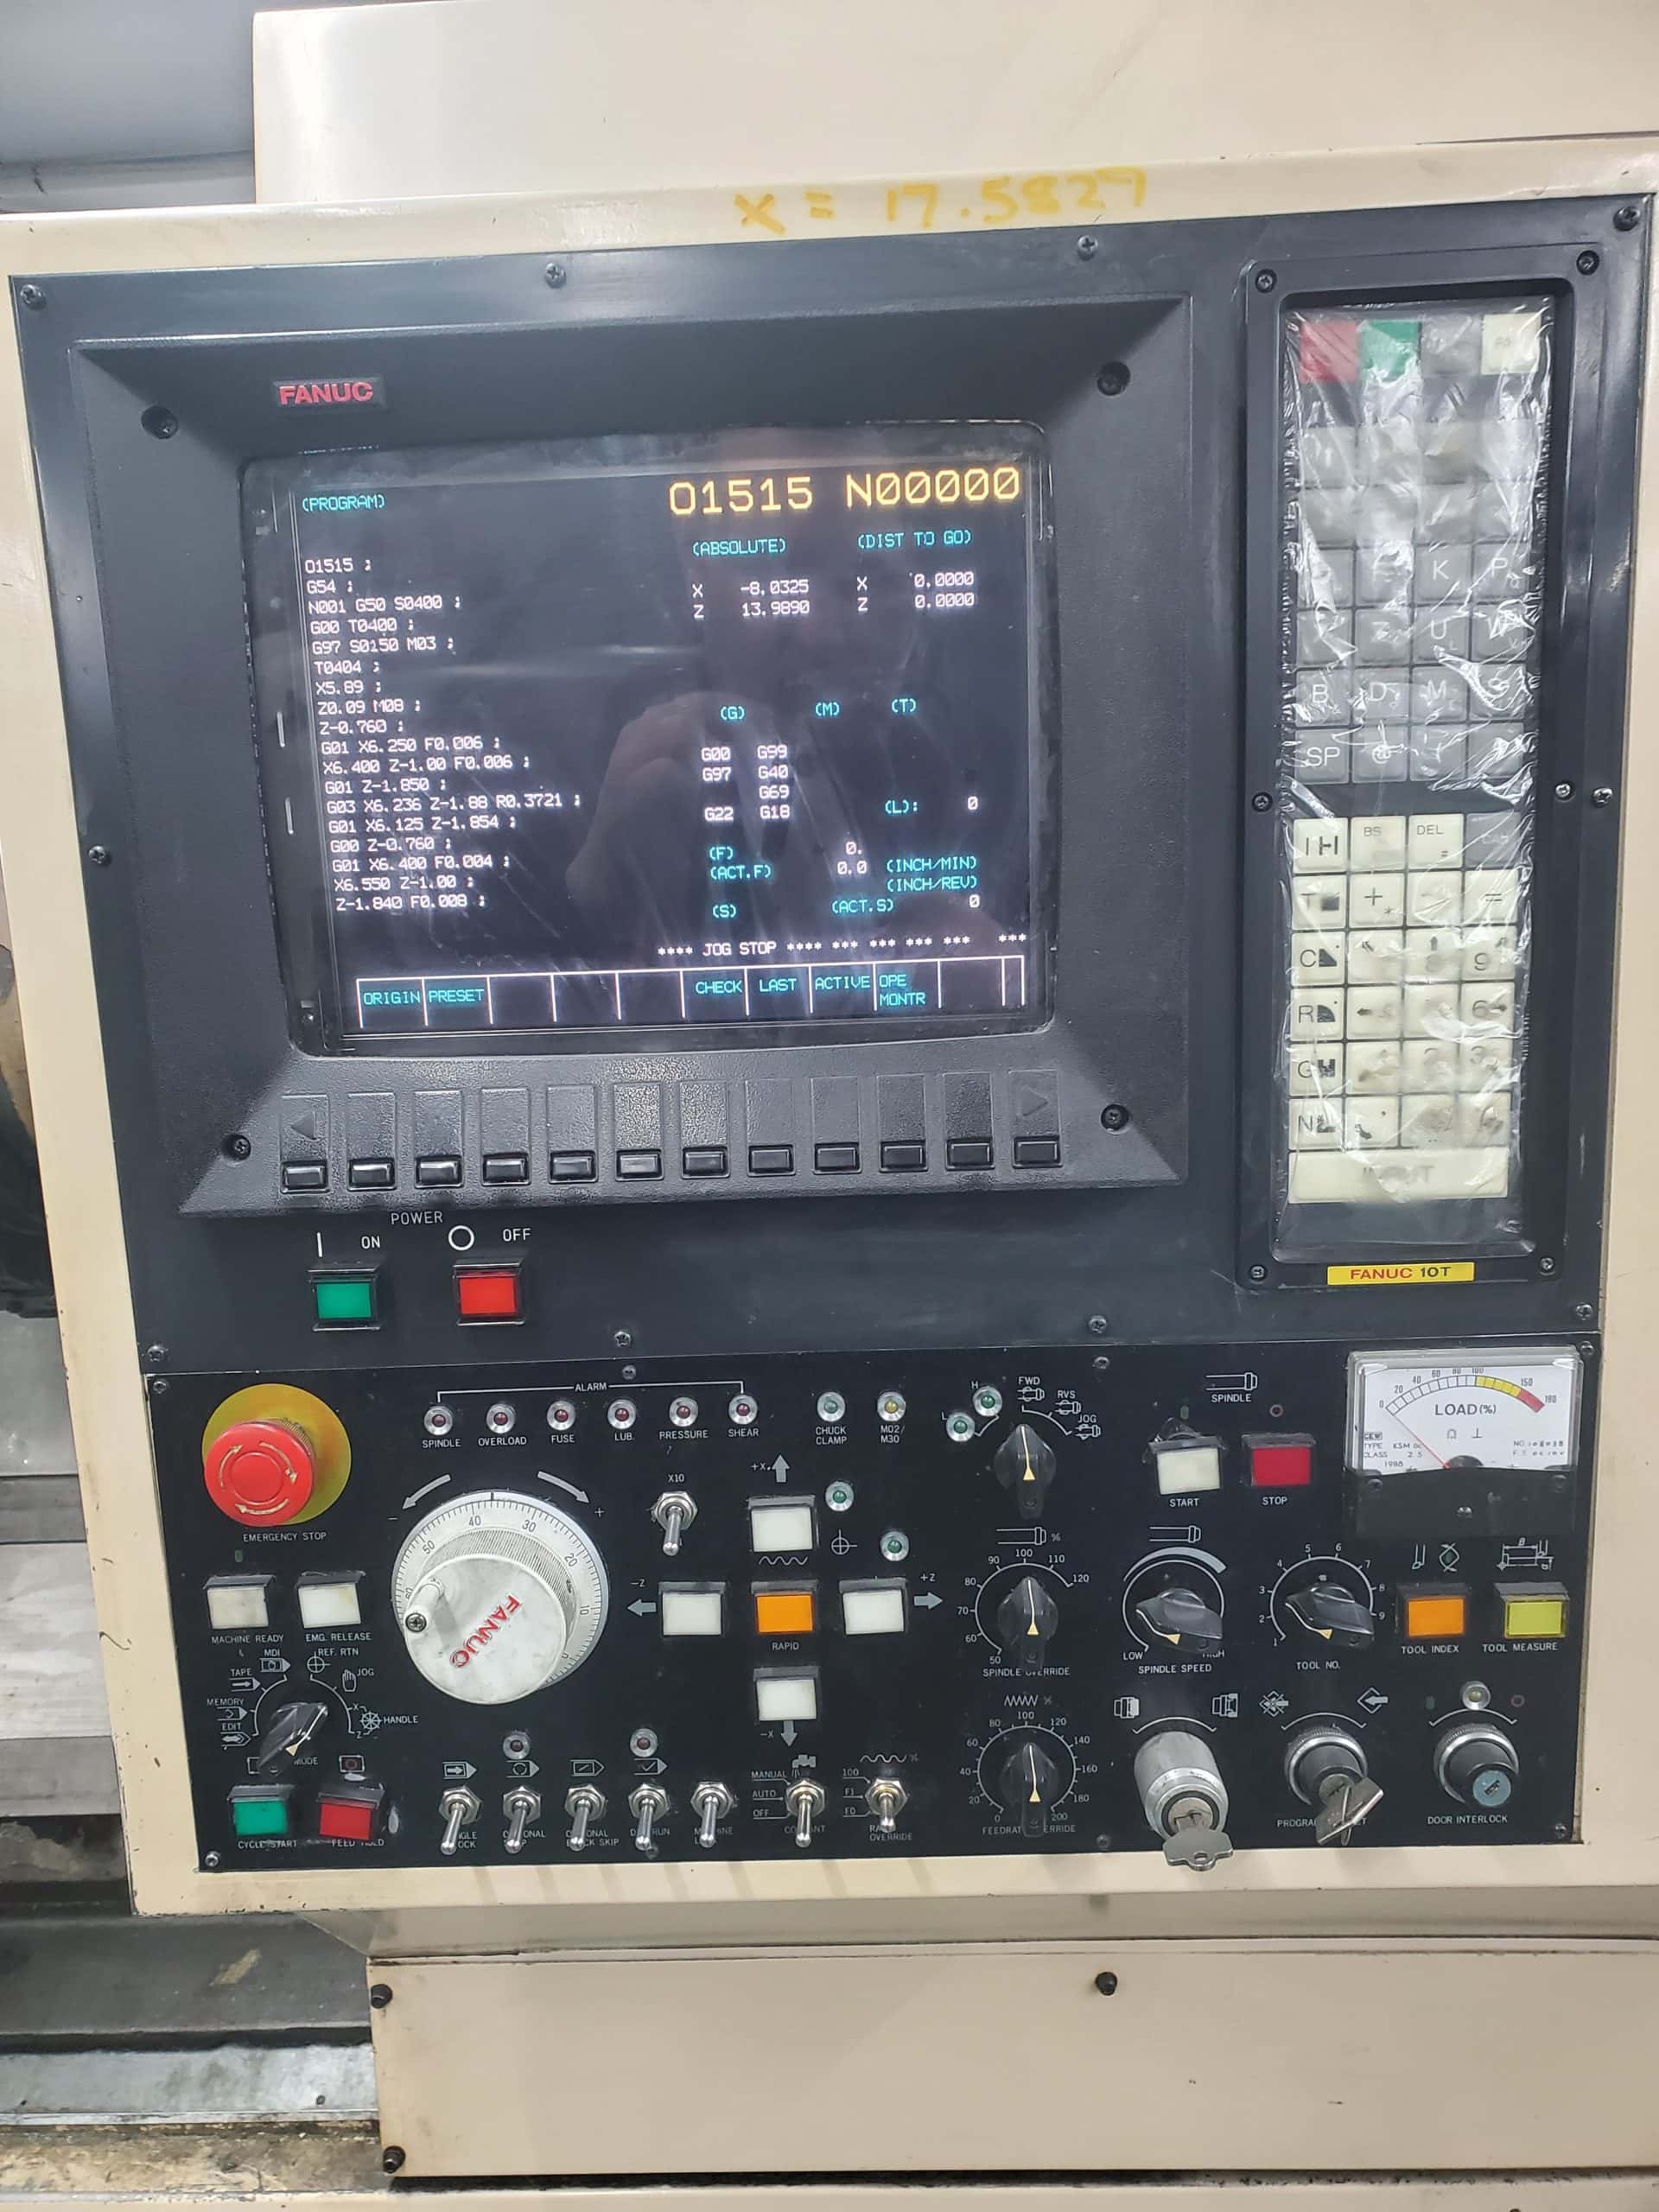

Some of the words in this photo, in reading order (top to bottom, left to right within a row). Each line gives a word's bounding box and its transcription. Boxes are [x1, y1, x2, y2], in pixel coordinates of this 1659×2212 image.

[887, 166, 1147, 229] 17.5827
[278, 382, 374, 405] FANUC
[669, 476, 814, 516] O1515
[845, 467, 1020, 508] N00000
[302, 493, 385, 512] (PROGRAM)
[692, 536, 787, 557] (ABSOLUTE)
[858, 531, 905, 550] (DIST
[943, 529, 973, 547] GO)
[307, 580, 336, 594] G54
[856, 576, 868, 591] X
[914, 571, 975, 588] 0.0000
[692, 583, 703, 598] X
[740, 579, 810, 596] -8.0325
[308, 600, 346, 615] N001
[355, 597, 386, 613] G50
[394, 594, 443, 611] S0400
[914, 593, 975, 608] 0.0000
[741, 601, 810, 618] 13.9890
[310, 620, 340, 634] G00
[348, 617, 397, 633] T0400
[312, 640, 340, 655] G97
[349, 638, 399, 653] S0150
[407, 636, 436, 652] M03
[314, 659, 362, 675] T0404
[315, 679, 364, 696] X5.89
[317, 700, 365, 715] Z0.09
[373, 698, 404, 713] M08
[720, 705, 746, 721] (G)
[815, 702, 840, 717] (M)
[891, 698, 917, 714] (T)
[320, 719, 387, 735] Z-0.760
[321, 741, 349, 755] G01
[359, 738, 417, 753] X6.250
[424, 735, 483, 752] F0.006
[701, 747, 731, 762] G00
[757, 744, 788, 760] G99
[323, 760, 380, 775] X6.400
[389, 757, 447, 772] Z-1.00
[454, 754, 513, 770] F0.006
[702, 766, 732, 782] G97
[758, 765, 788, 779] G40
[325, 780, 353, 795] G01
[362, 778, 429, 793] Z-1.850
[759, 785, 789, 799] G69
[327, 800, 356, 814] G03
[364, 798, 423, 813] X6.236
[429, 795, 488, 810] Z-1.88
[496, 792, 563, 809] R0.3721
[704, 807, 734, 822] G22
[760, 804, 790, 820] G18
[328, 820, 356, 835] G01
[365, 817, 423, 833] X6.125
[432, 815, 499, 830] Z-1.854
[1416, 824, 1444, 836] DEL
[331, 840, 359, 854] G00
[367, 836, 435, 852] Z-0.760
[709, 846, 734, 861] (F)
[332, 859, 359, 873] G01
[369, 856, 427, 872] X6.400
[435, 855, 493, 869] F0.004
[710, 864, 772, 880] (ACT.F)
[837, 861, 868, 875] 0.0
[887, 856, 977, 873] (INCH/MIN)
[334, 876, 391, 892] X6.550
[400, 874, 456, 890] Z-1.00
[887, 875, 978, 892] (INCH/REV)
[336, 895, 403, 912] Z-1.840
[410, 893, 467, 909] F0.008
[712, 904, 737, 919] (S)
[832, 899, 894, 914] (ACT.S)
[702, 942, 733, 957] JOG
[740, 940, 777, 956] STOP
[695, 980, 743, 995] CHECK
[759, 977, 798, 993] LAST
[815, 975, 871, 991] ACTIVE
[879, 973, 907, 988] OPE
[363, 991, 421, 1006] ORIGIN
[428, 988, 485, 1003] PRESET
[879, 992, 926, 1007] MONTR
[391, 1211, 443, 1224] POWER
[502, 1228, 531, 1242] OFF
[361, 1236, 381, 1249] ON
[1350, 1268, 1413, 1281] FANUC
[1420, 1266, 1452, 1279] 10T
[575, 1382, 607, 1392] ALARM
[1018, 1376, 1040, 1386] FWD
[1057, 1389, 1076, 1400] RVS
[1211, 1393, 1252, 1404] SPINDLE
[1077, 1414, 1097, 1424] JOG
[550, 1433, 575, 1444] FUSE
[659, 1429, 709, 1440] PRESSURE
[728, 1427, 760, 1438] SHEAR
[815, 1427, 846, 1436] CHUCK
[422, 1438, 461, 1448] SPINDLE
[478, 1436, 527, 1446] OVERLOAD
[815, 1436, 848, 1446] CLAMP
[1169, 1497, 1199, 1508] START
[1262, 1496, 1287, 1507] STOP
[468, 1515, 482, 1527] 40
[521, 1519, 537, 1533] 30
[243, 1533, 298, 1542] EMERGENCY
[302, 1531, 327, 1541] STOP
[564, 1552, 578, 1568] 20
[1015, 1549, 1033, 1558] 100
[1048, 1554, 1065, 1564] 110
[1072, 1574, 1090, 1583] 120
[212, 1635, 251, 1643] MACHINE
[255, 1634, 284, 1643] READY
[331, 1632, 372, 1641] RELEASE
[449, 1594, 522, 1669] FANUC
[340, 1647, 359, 1656] RTN
[772, 1642, 800, 1651] RAPID
[1401, 1645, 1427, 1655] TOOL
[1431, 1644, 1460, 1654] INDEX
[1482, 1643, 1507, 1653] TOOL
[1512, 1642, 1558, 1651] MEASURE
[1123, 1651, 1143, 1660] LOW
[231, 1668, 251, 1676] TAPE
[357, 1668, 374, 1677] JOG
[982, 1668, 1022, 1677] SPINDLE
[1138, 1665, 1176, 1675] SPINDLE
[1181, 1663, 1211, 1673] SPEED
[1296, 1661, 1321, 1670] TOOL
[207, 1698, 245, 1707] MEMORY
[383, 1715, 419, 1725] HANDLE
[1017, 1711, 1035, 1719] 100
[1050, 1718, 1067, 1726] 120
[221, 1722, 242, 1732] EDIT
[1073, 1735, 1090, 1745] 140
[751, 1770, 786, 1779] MANUAL
[1427, 1815, 1452, 1825] DOOR
[1457, 1815, 1508, 1824] INTERLOCK
[869, 1832, 913, 1841] OVERRIDE
[238, 1840, 264, 1849] CYCLE
